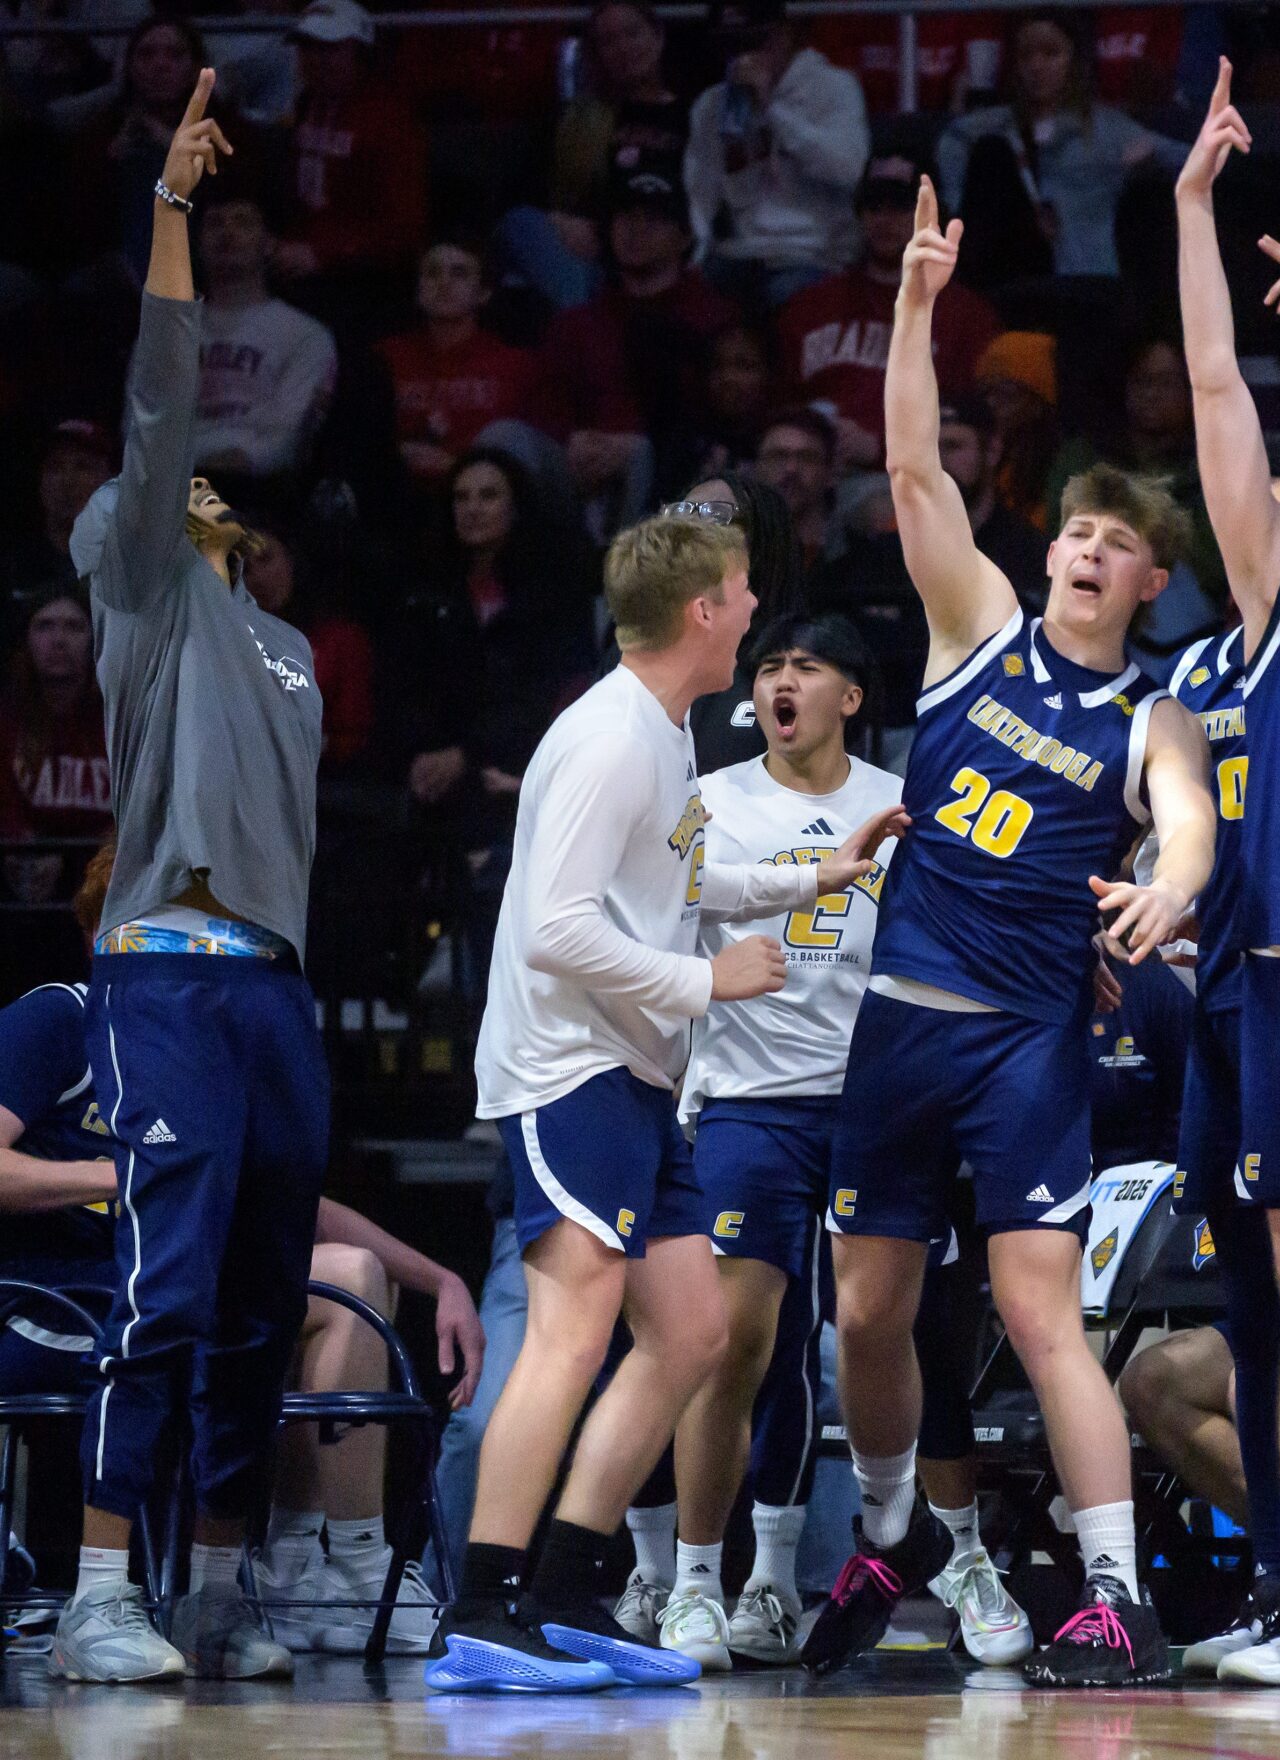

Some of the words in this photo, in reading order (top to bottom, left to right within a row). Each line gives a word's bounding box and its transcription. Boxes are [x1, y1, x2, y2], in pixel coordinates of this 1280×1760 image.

[730, 700, 757, 728] C
[933, 765, 1035, 859] 20
[784, 950, 861, 965] CS.BASKETBALL
[142, 1132, 178, 1145] adidas
[834, 1188, 858, 1217] C
[1113, 1179, 1154, 1202] 2025
[616, 1208, 636, 1238] C
[713, 1210, 746, 1238] C
